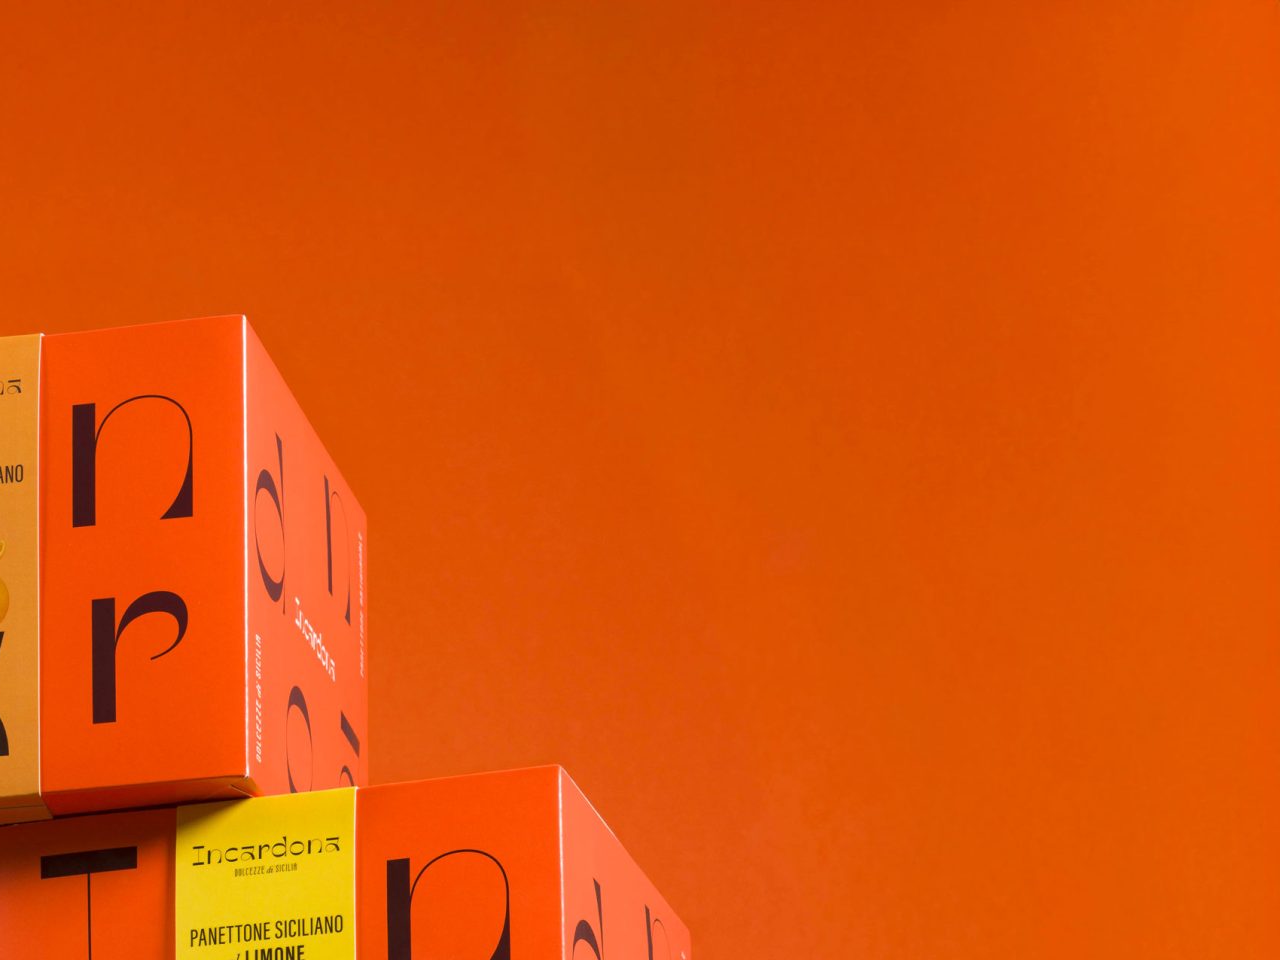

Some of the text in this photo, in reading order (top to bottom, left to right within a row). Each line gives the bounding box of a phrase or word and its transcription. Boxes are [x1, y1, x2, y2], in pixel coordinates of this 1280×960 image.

[255, 696, 263, 763] DOLCEZZE
[192, 836, 340, 866] Incardona
[235, 866, 264, 877] DOLCEZZE
[276, 863, 297, 872] SICILIA
[190, 915, 343, 947] PANETTONE SICILIANO
